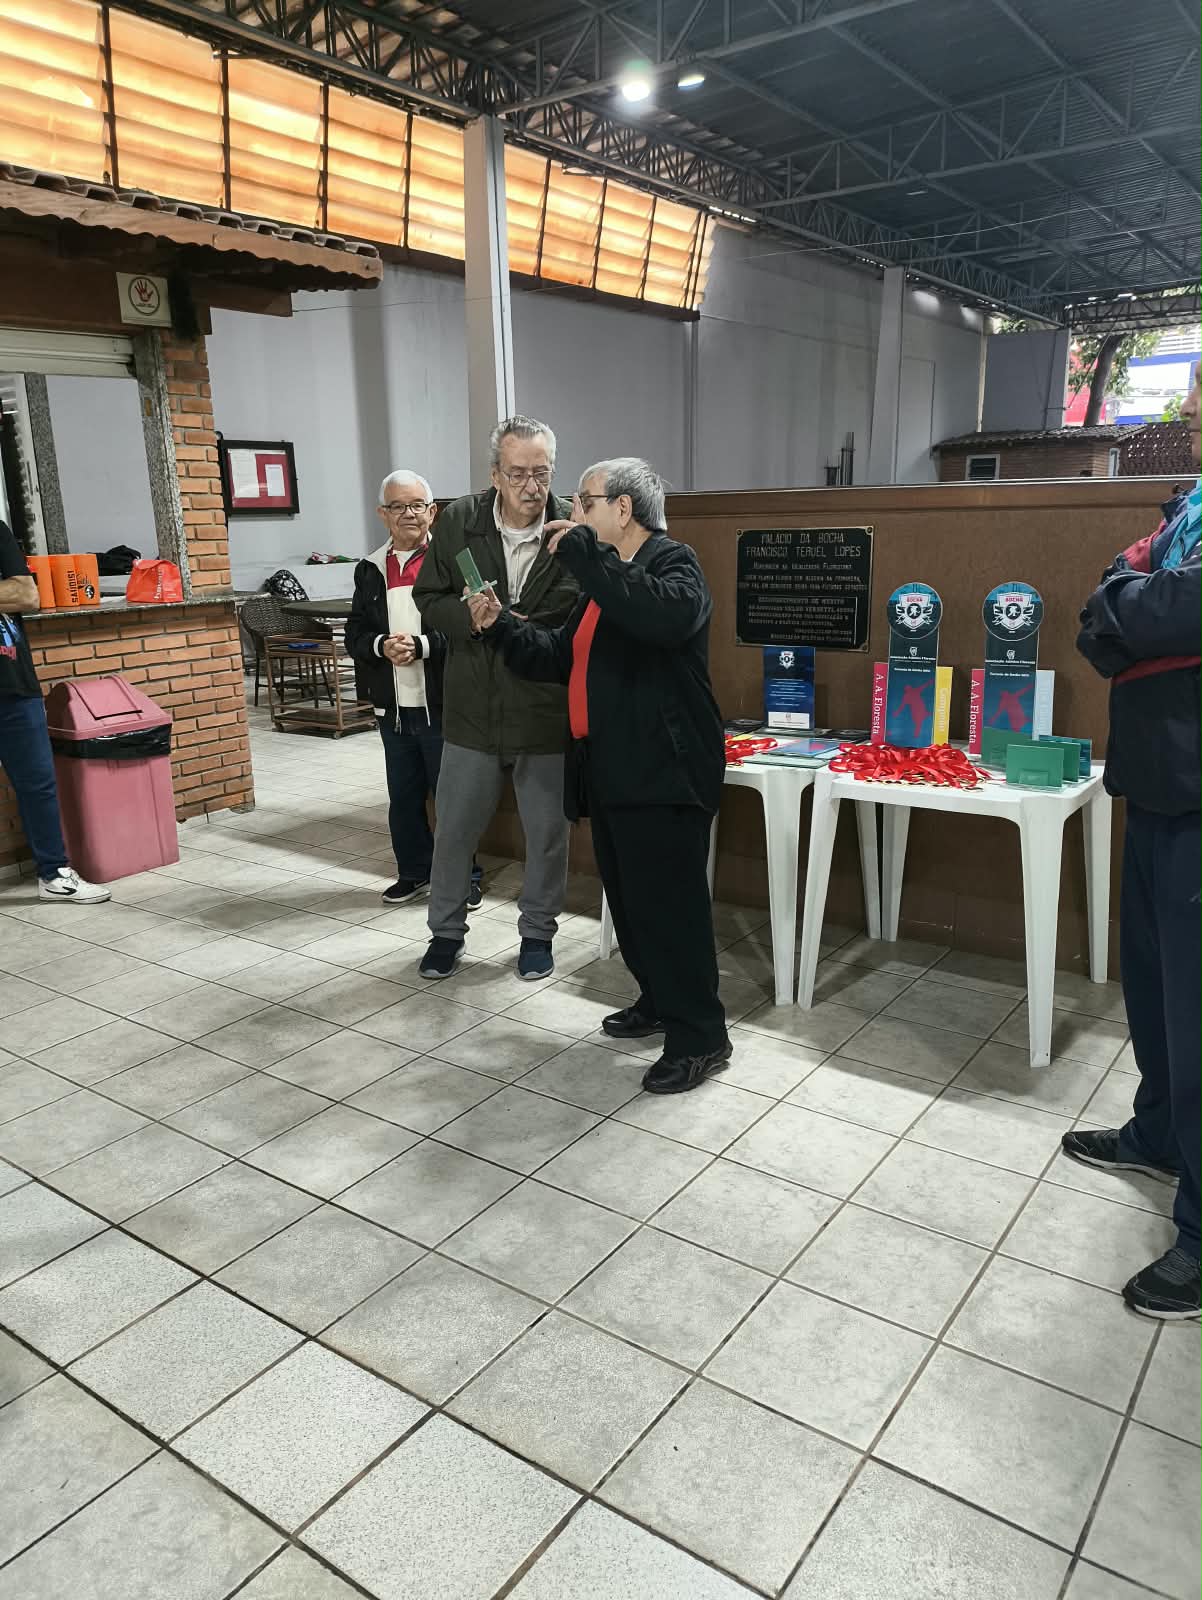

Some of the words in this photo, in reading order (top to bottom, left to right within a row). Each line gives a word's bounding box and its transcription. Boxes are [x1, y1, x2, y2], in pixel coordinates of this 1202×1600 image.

[799, 533, 810, 544] DA
[818, 532, 844, 544] BOCHA
[746, 546, 788, 558] FRANCISCO
[796, 546, 827, 558] TERUEL
[834, 546, 861, 557] LOPES
[876, 673, 884, 683] A.
[875, 685, 883, 695] A.
[971, 679, 980, 690] A.
[970, 692, 980, 703] A.
[873, 697, 883, 734] Floresta
[969, 704, 980, 744] Floresta
